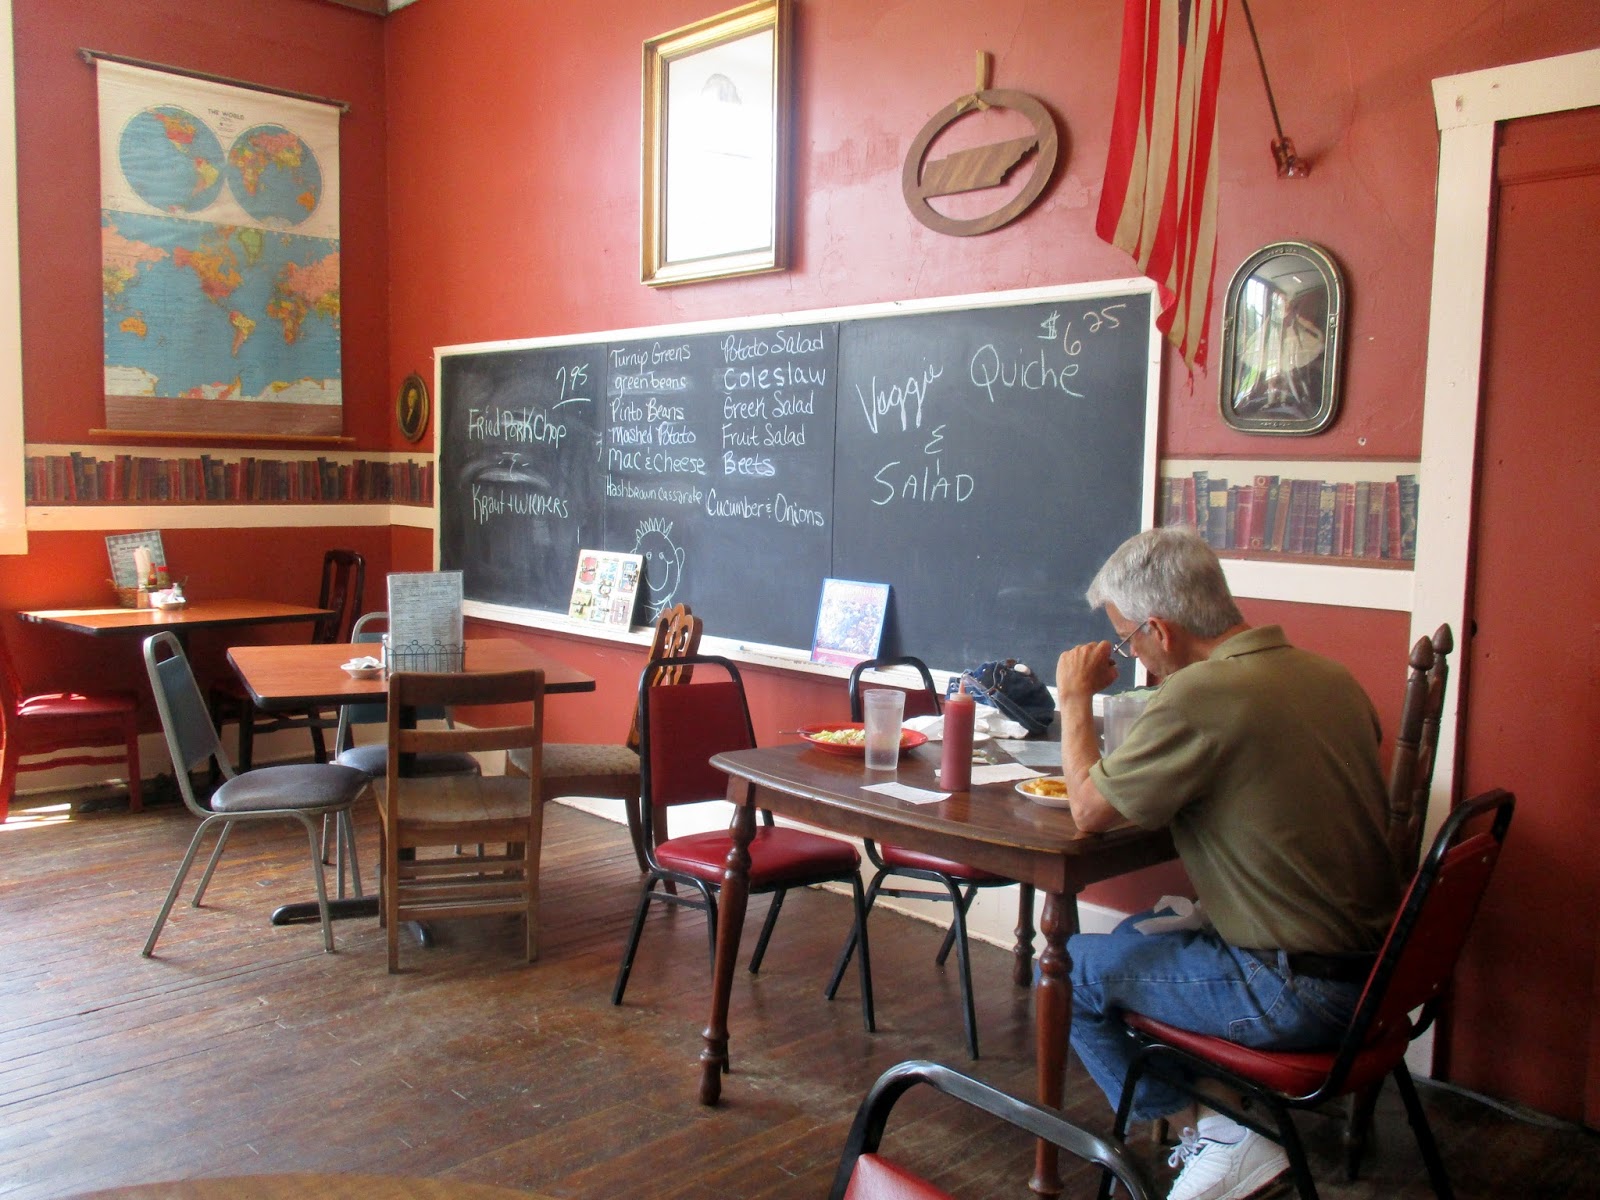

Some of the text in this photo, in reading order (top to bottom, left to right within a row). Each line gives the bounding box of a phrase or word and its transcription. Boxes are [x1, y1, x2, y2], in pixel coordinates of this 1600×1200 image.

[208, 108, 245, 121] THE WORLD
[609, 341, 691, 375] Turnip Greens
[720, 330, 824, 363] Potato Salad
[855, 343, 1085, 434] Veggie Quiche
[609, 397, 685, 423] Pinto Beans
[723, 389, 815, 420] Greek Salad
[533, 409, 567, 449] Chop
[607, 421, 697, 446] Mashed Potato
[721, 422, 806, 449] Fruit Salad
[722, 450, 776, 477] Beets
[706, 488, 763, 519] Cucumber
[774, 492, 825, 527] Onions
